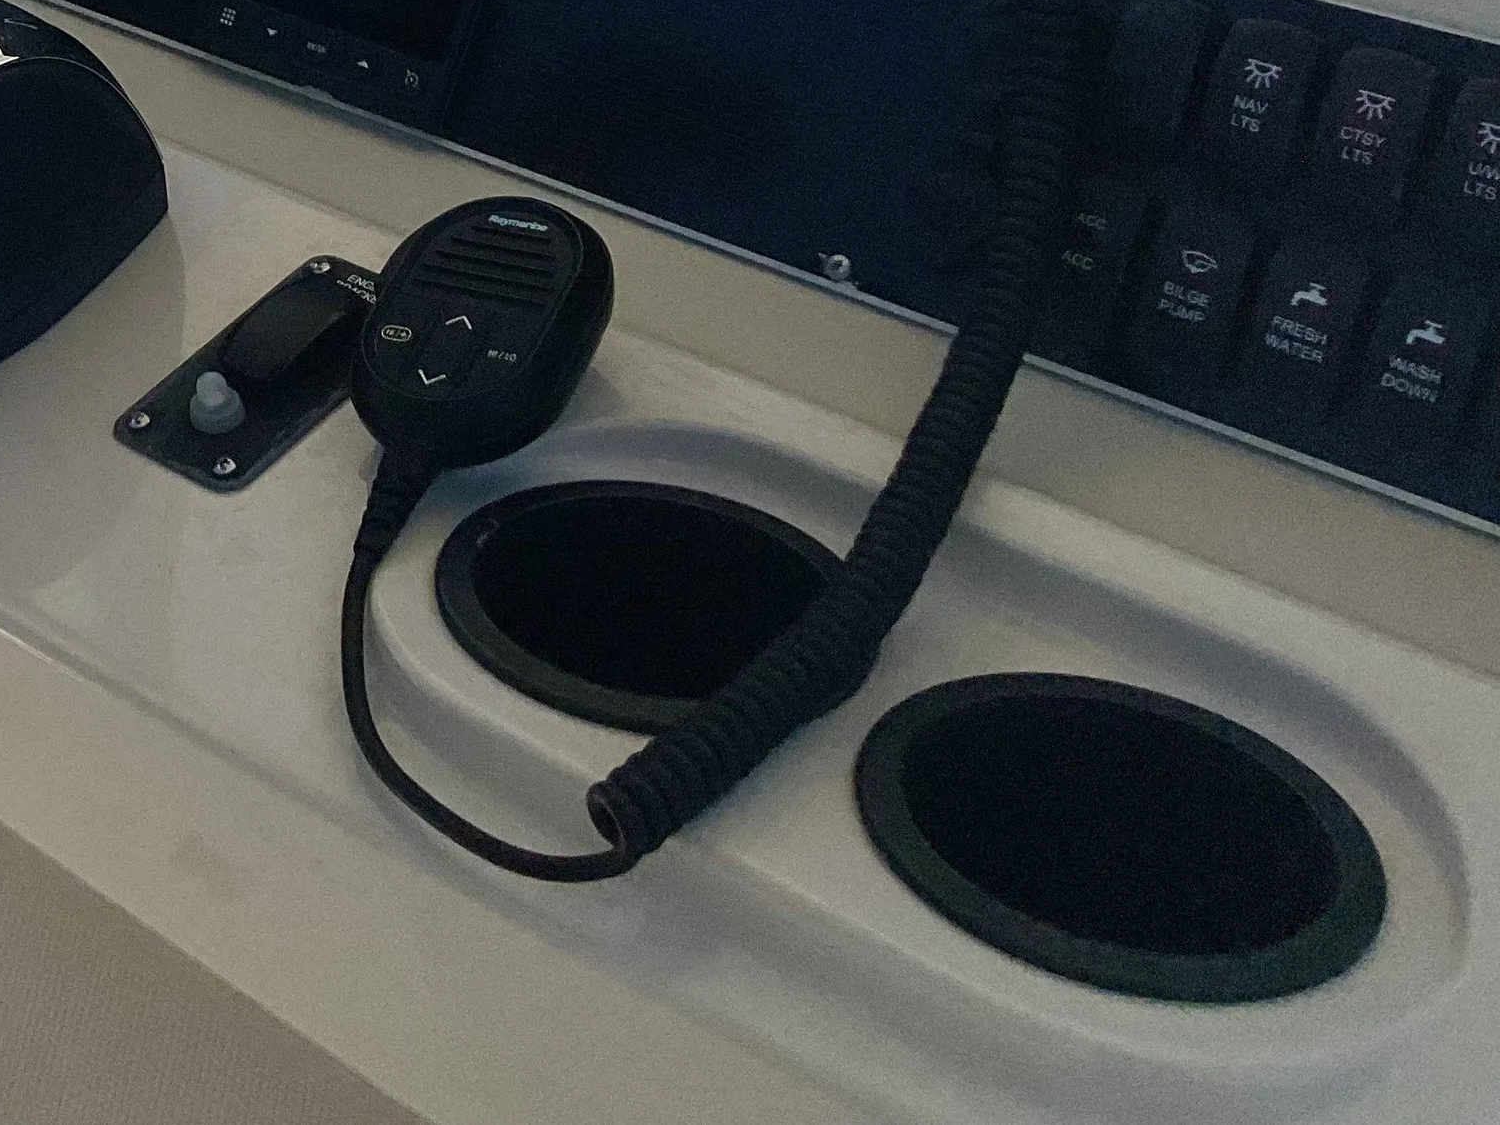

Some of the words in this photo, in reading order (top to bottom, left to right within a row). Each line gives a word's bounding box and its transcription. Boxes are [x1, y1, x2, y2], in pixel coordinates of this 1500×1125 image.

[1232, 95, 1269, 113] NAV
[1231, 114, 1260, 132] LTS
[1340, 126, 1386, 147] CTSY
[1342, 146, 1373, 165] LTS
[1463, 180, 1497, 200] LTS
[489, 215, 548, 231] Raymarine
[1062, 250, 1093, 271] ACC
[1163, 280, 1212, 307] BILGE
[1158, 298, 1206, 322] PUMP
[1272, 315, 1327, 345] FRESH
[1265, 333, 1323, 364] WATER
[1389, 354, 1442, 384] WASH
[1381, 373, 1438, 403] DOWN
